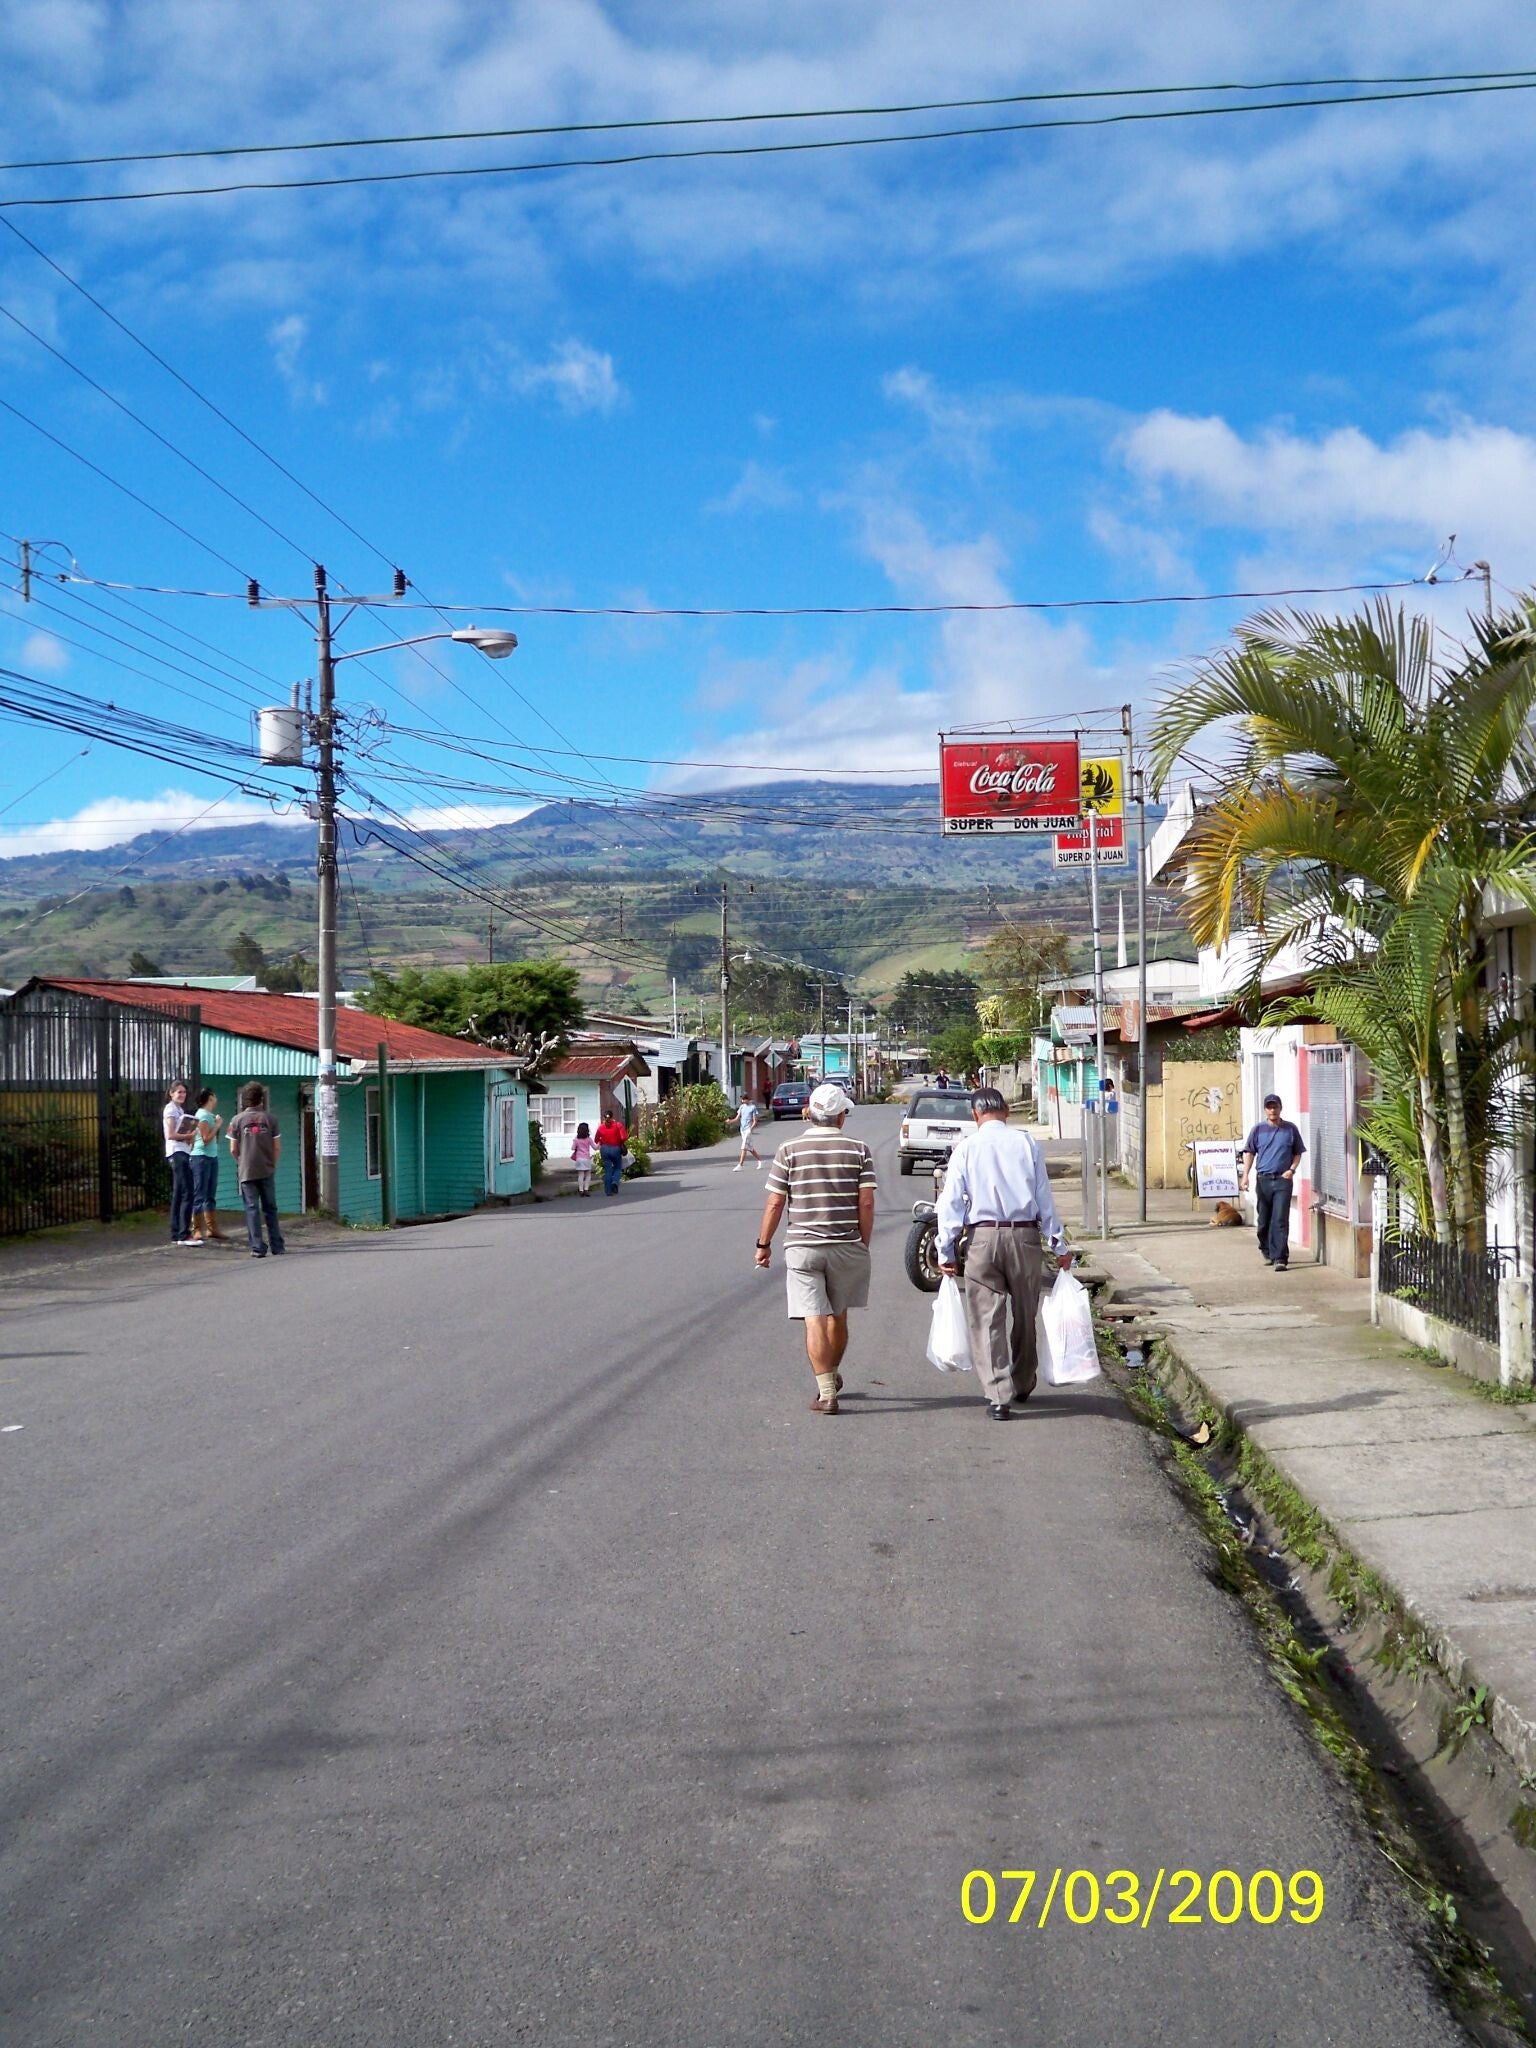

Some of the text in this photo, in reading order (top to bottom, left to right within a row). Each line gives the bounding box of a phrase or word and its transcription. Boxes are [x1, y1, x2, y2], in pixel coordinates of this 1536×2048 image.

[950, 816, 1075, 830] SUPER DON JUAN
[1058, 852, 1083, 862] SUPER
[1103, 850, 1123, 860] JUAN
[1180, 1116, 1221, 1137] Padre
